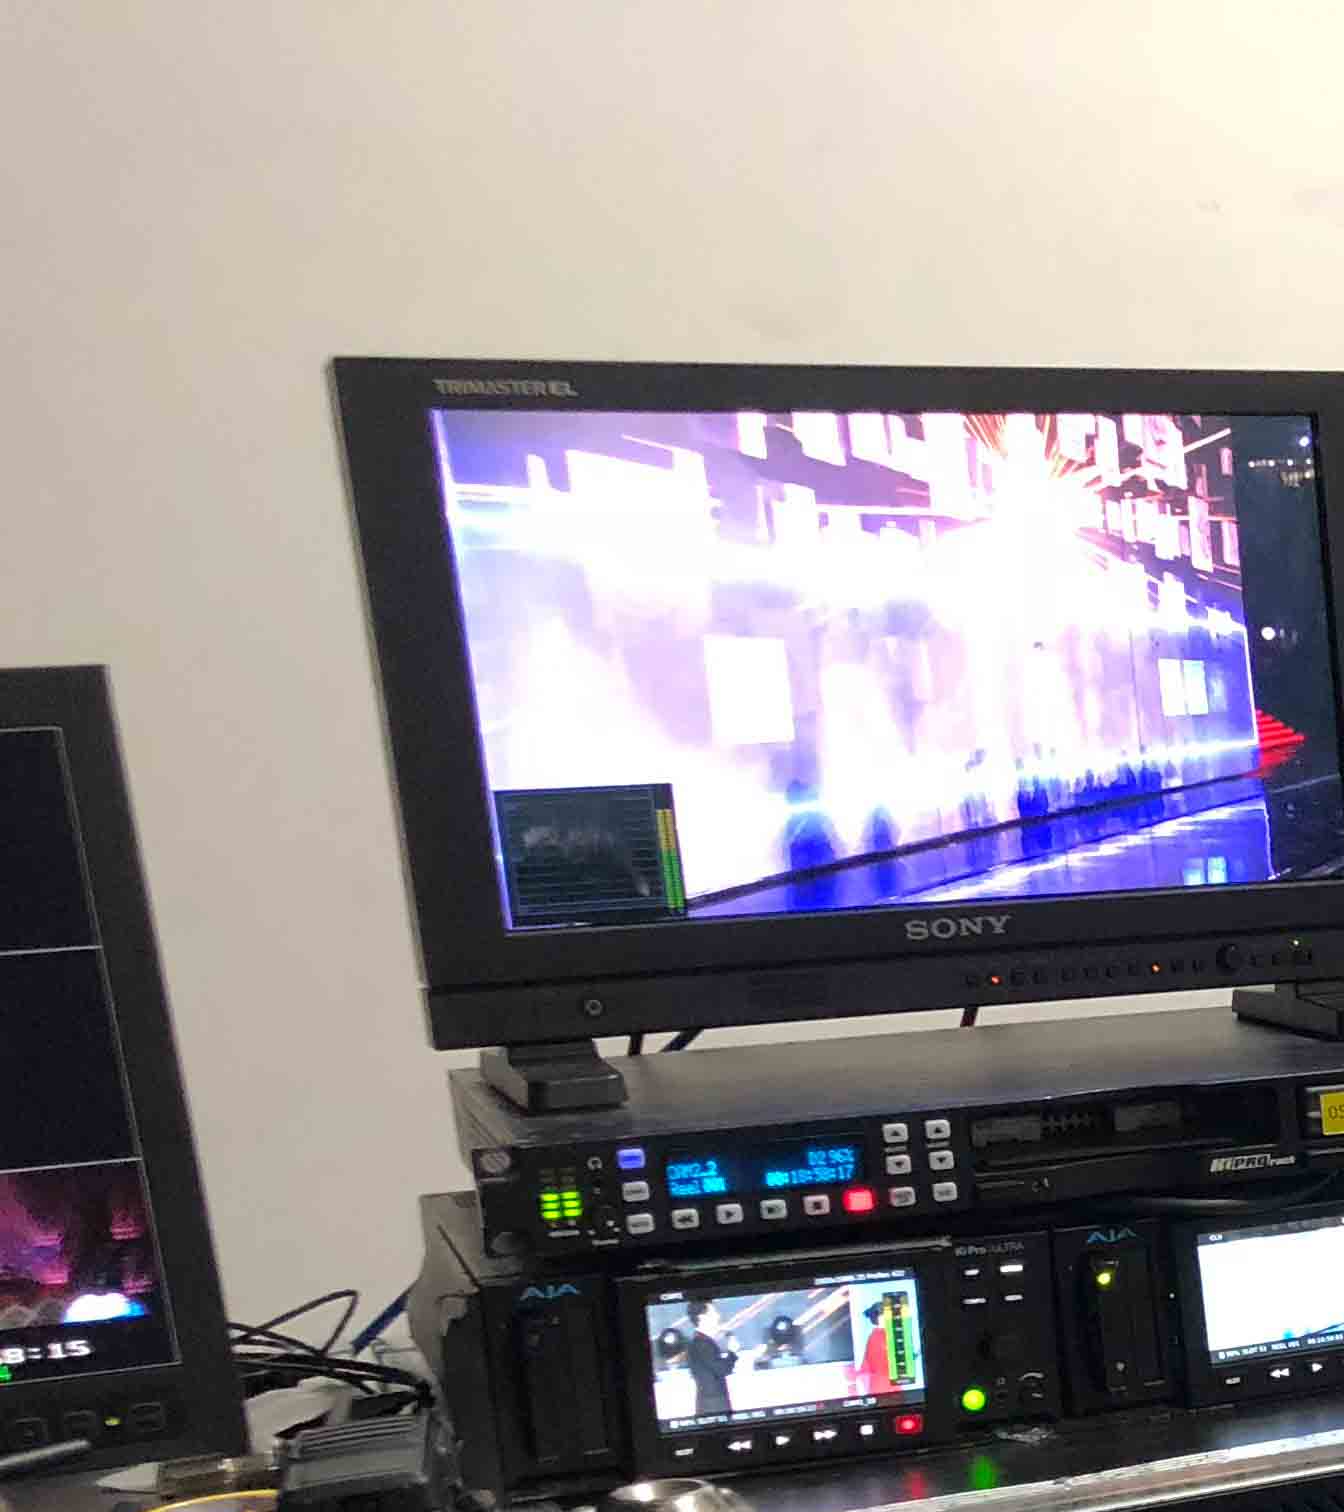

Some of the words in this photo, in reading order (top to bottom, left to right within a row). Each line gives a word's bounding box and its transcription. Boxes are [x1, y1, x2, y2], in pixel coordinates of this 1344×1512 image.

[432, 379, 546, 395] TRIMASTER
[550, 382, 580, 396] EL
[905, 914, 1012, 941] SONY
[1086, 1226, 1138, 1246] AJA
[518, 1283, 582, 1302] AJA
[0, 1339, 92, 1364] 8:15
